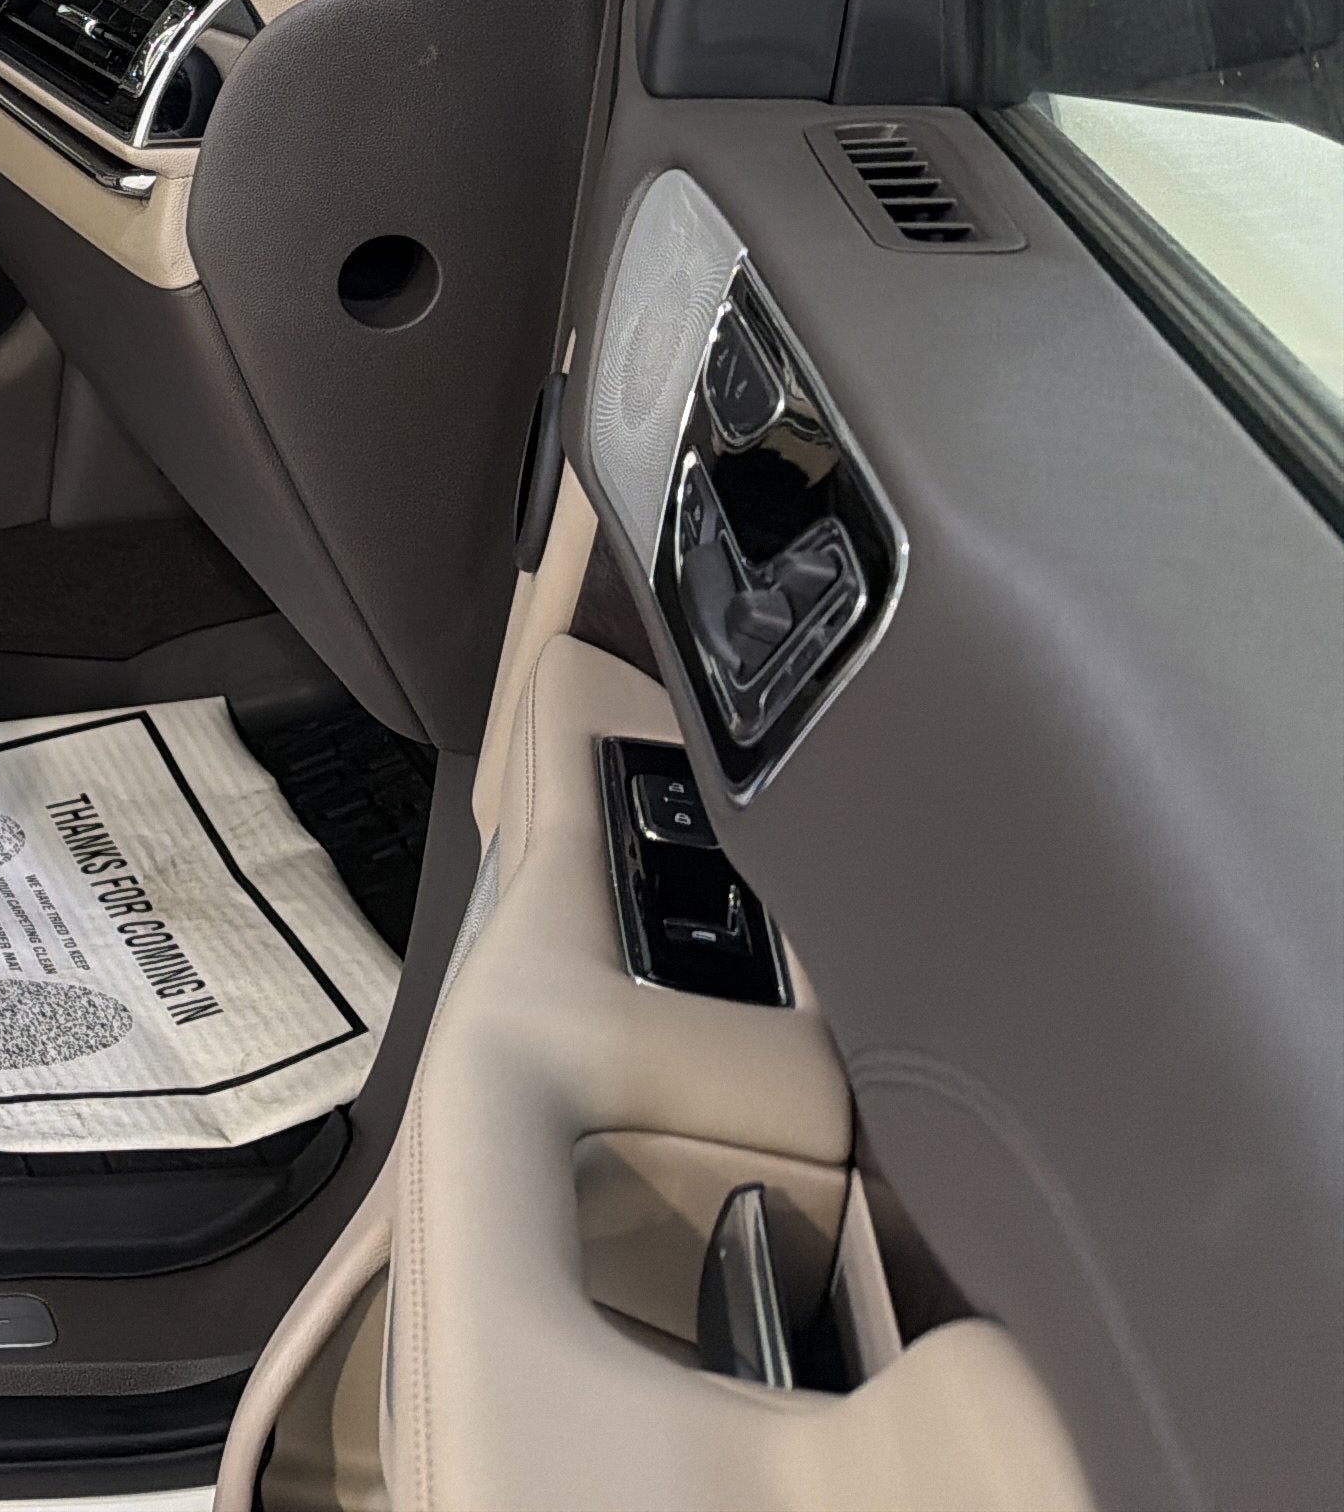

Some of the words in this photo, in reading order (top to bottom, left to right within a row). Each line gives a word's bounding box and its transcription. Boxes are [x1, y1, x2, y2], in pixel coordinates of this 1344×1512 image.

[45, 792, 128, 875] THANKS
[25, 874, 42, 888] WE
[33, 889, 56, 911] HAVE
[90, 875, 154, 919] FOR
[47, 908, 69, 935] TRIED
[7, 899, 42, 944] CARPETING
[32, 946, 57, 975] CLEAN
[62, 937, 77, 948] TO
[2, 952, 23, 972] MAT
[69, 949, 90, 971] KEEP
[117, 920, 206, 999] COMING
[167, 996, 224, 1026] IN
